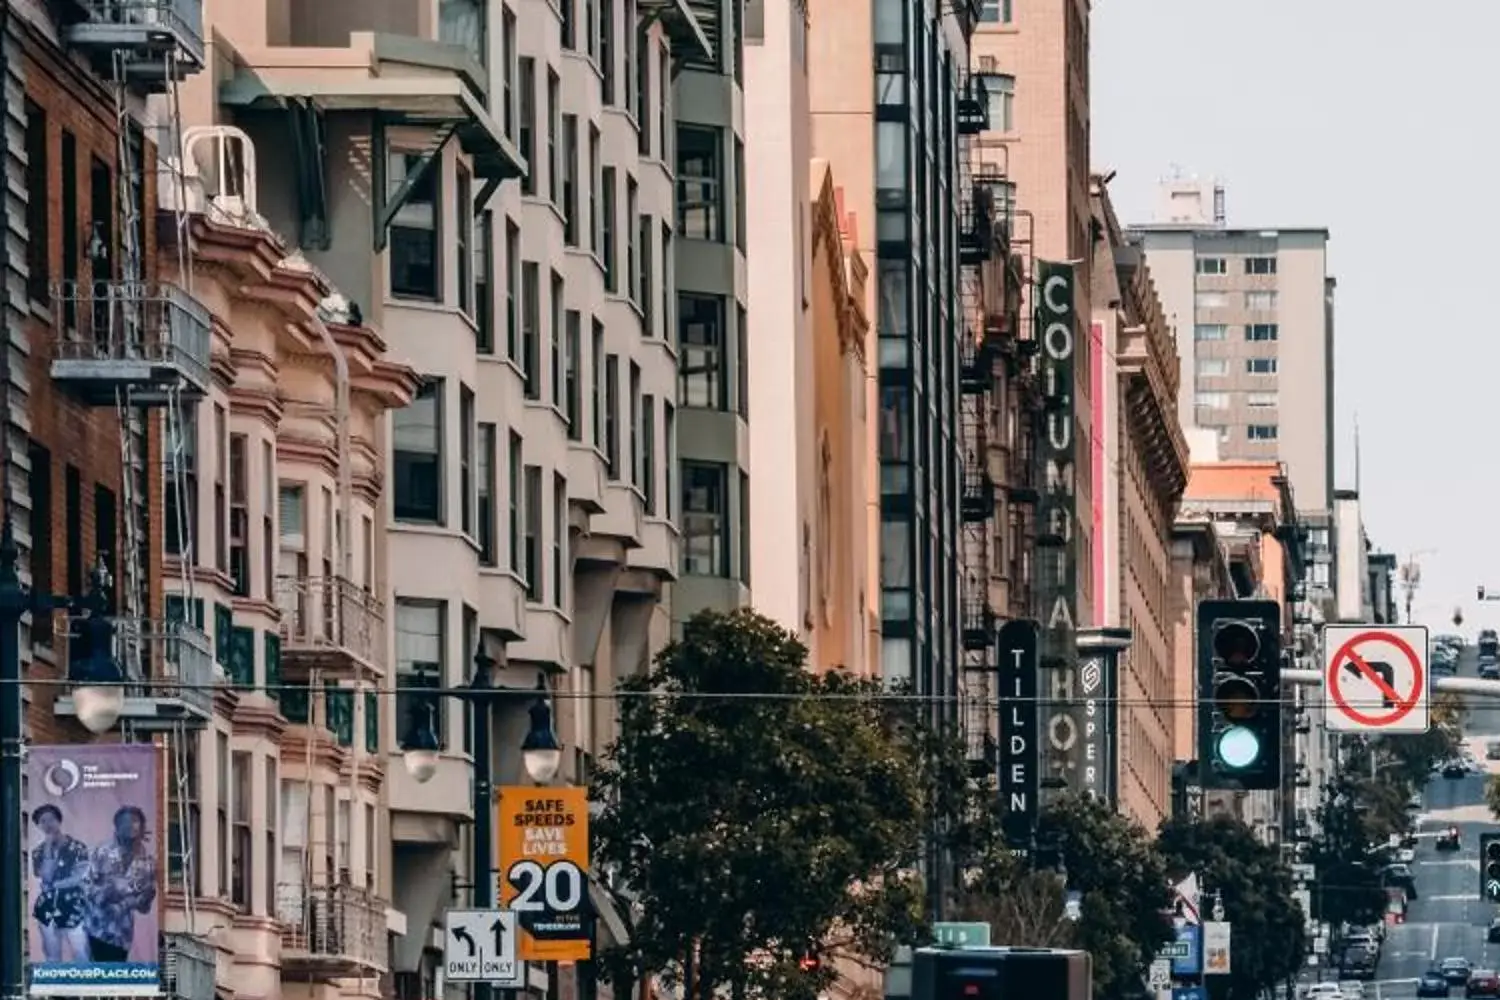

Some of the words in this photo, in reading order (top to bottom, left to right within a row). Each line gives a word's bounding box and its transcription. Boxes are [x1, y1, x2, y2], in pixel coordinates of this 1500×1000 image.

[1011, 650, 1026, 812] TILDEN
[525, 799, 564, 812] SAFE
[514, 813, 575, 826] SPEEDS
[524, 828, 565, 841] SAVE
[523, 842, 567, 856] LIVES
[508, 860, 581, 912] 20
[449, 962, 477, 973] ONLY
[484, 962, 512, 973] ONLY
